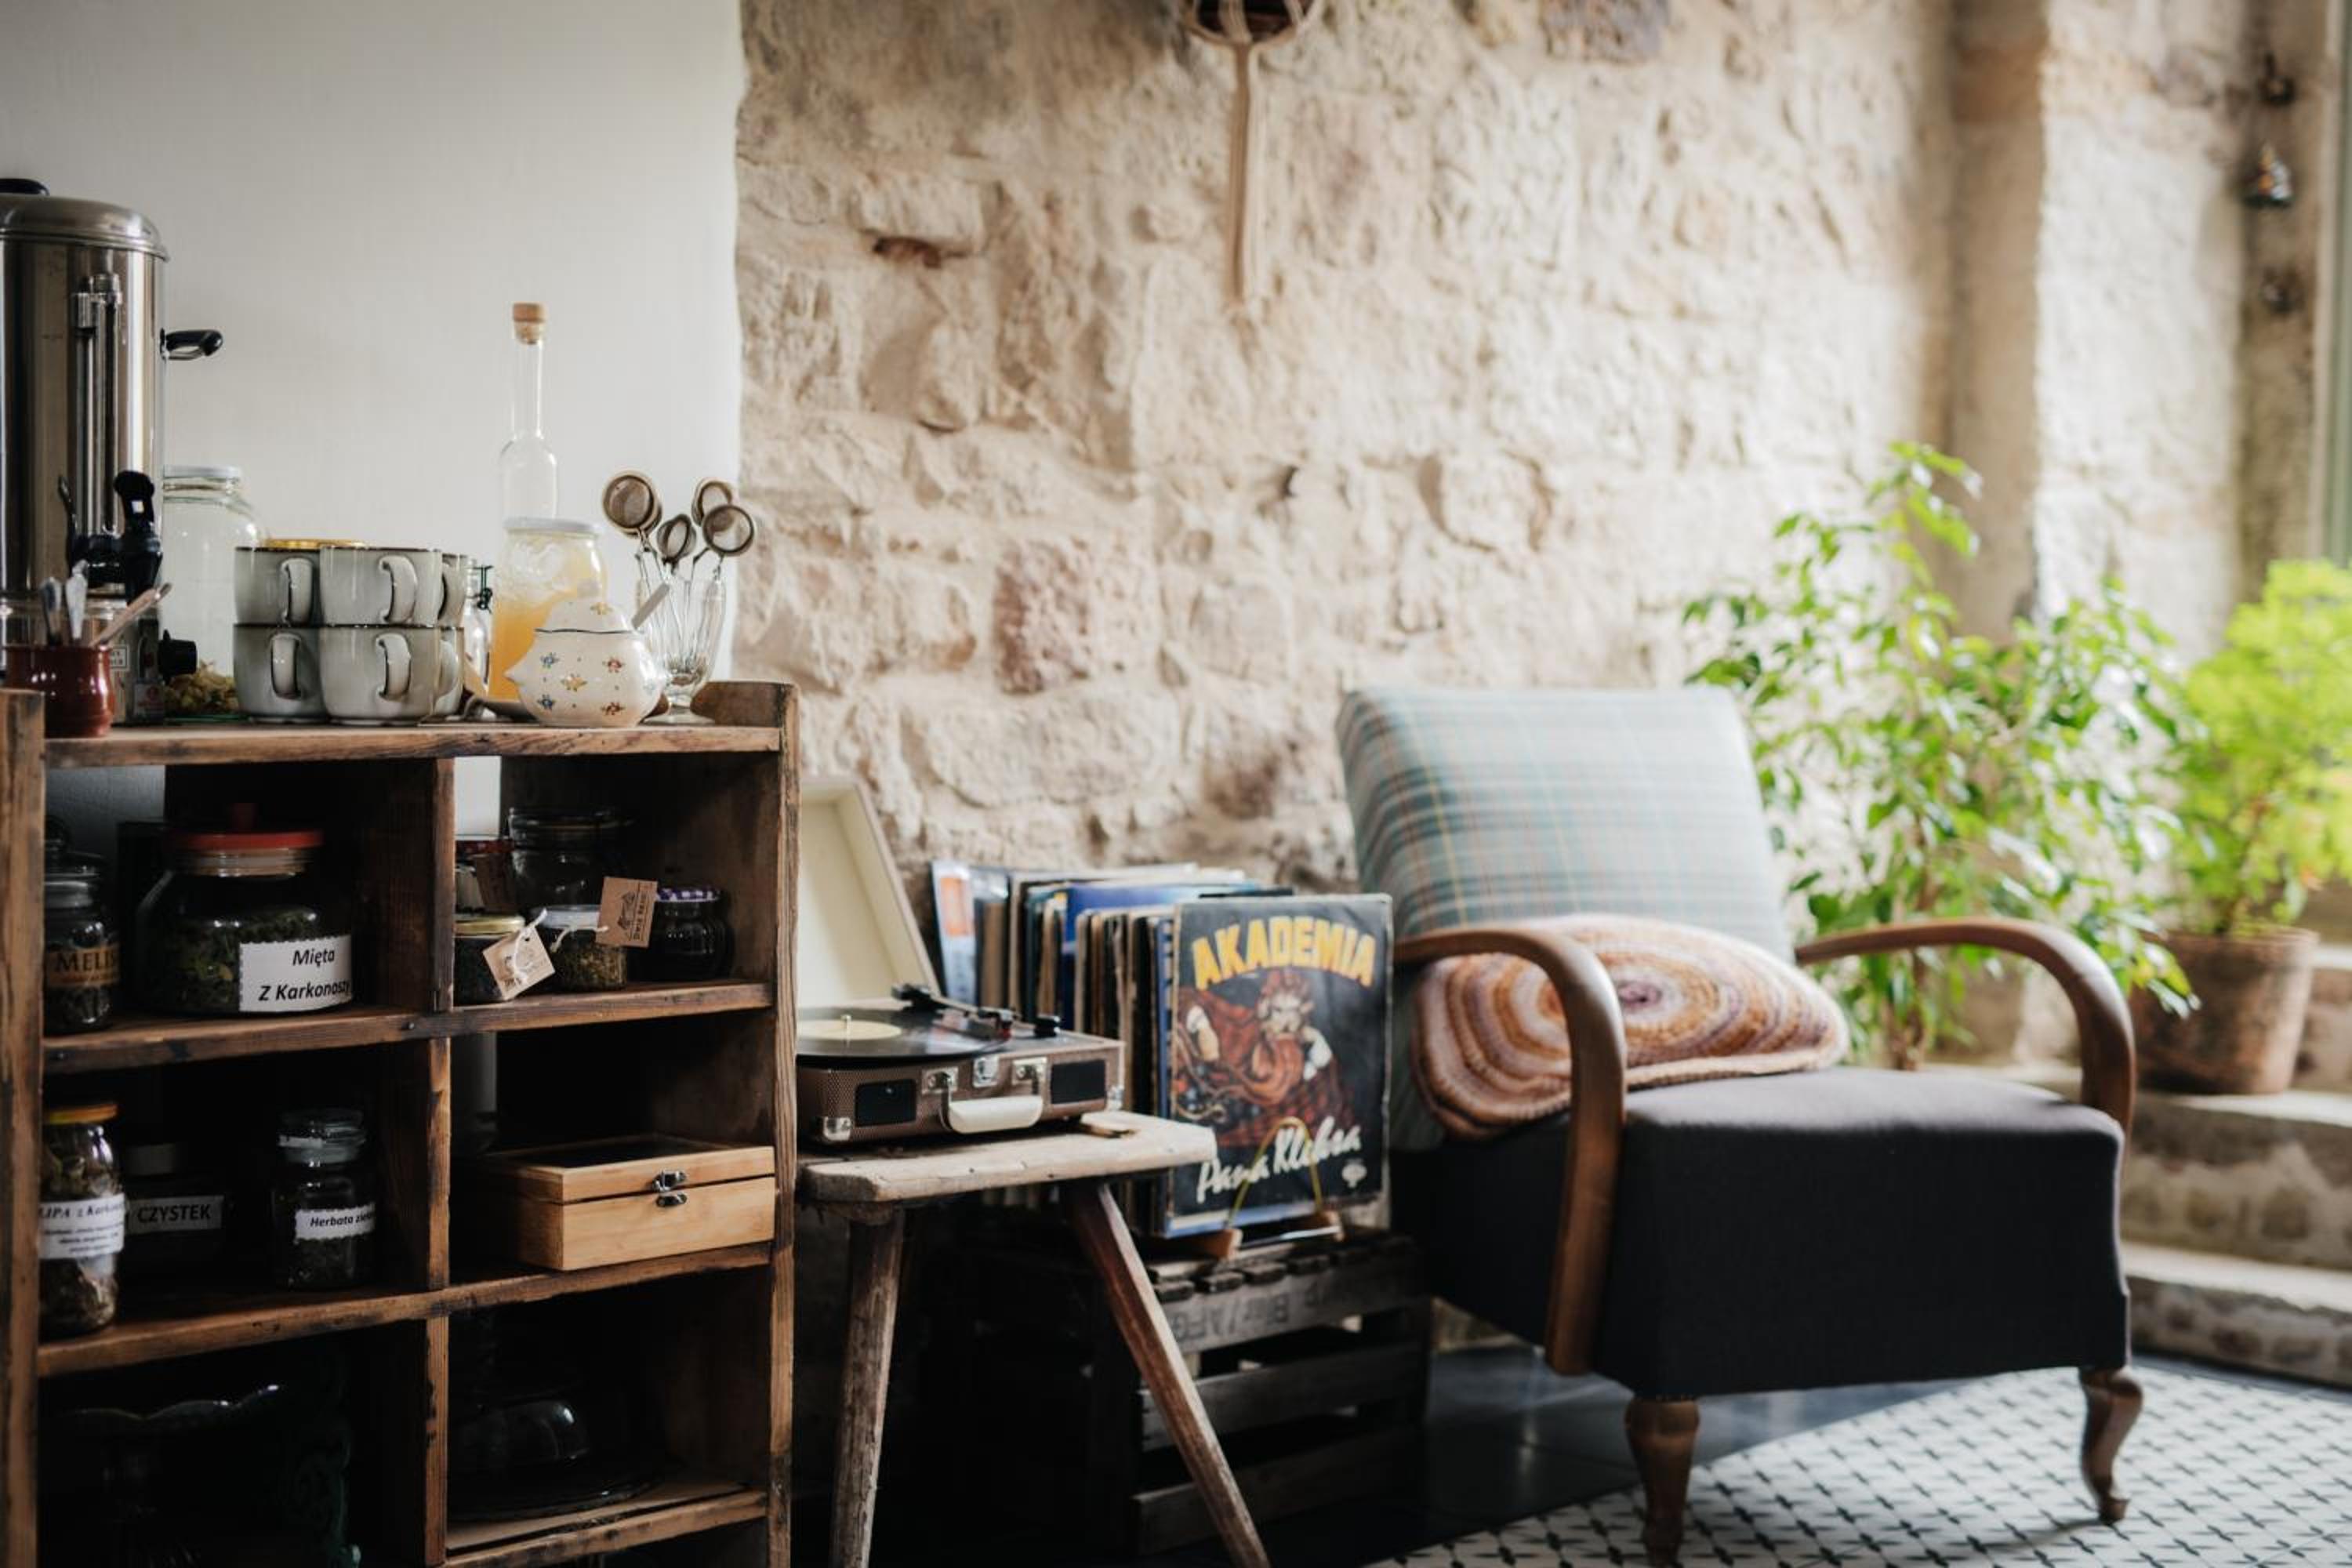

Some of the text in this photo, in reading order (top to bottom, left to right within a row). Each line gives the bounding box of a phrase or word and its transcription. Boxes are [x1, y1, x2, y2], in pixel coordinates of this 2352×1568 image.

[293, 948, 335, 967] Mięta
[1192, 916, 1376, 989] AKADEMIA
[258, 985, 271, 1000] Z
[1196, 1155, 1270, 1205] Pana
[138, 1204, 212, 1223] CZYSTEK
[310, 1216, 354, 1228] Herbata
